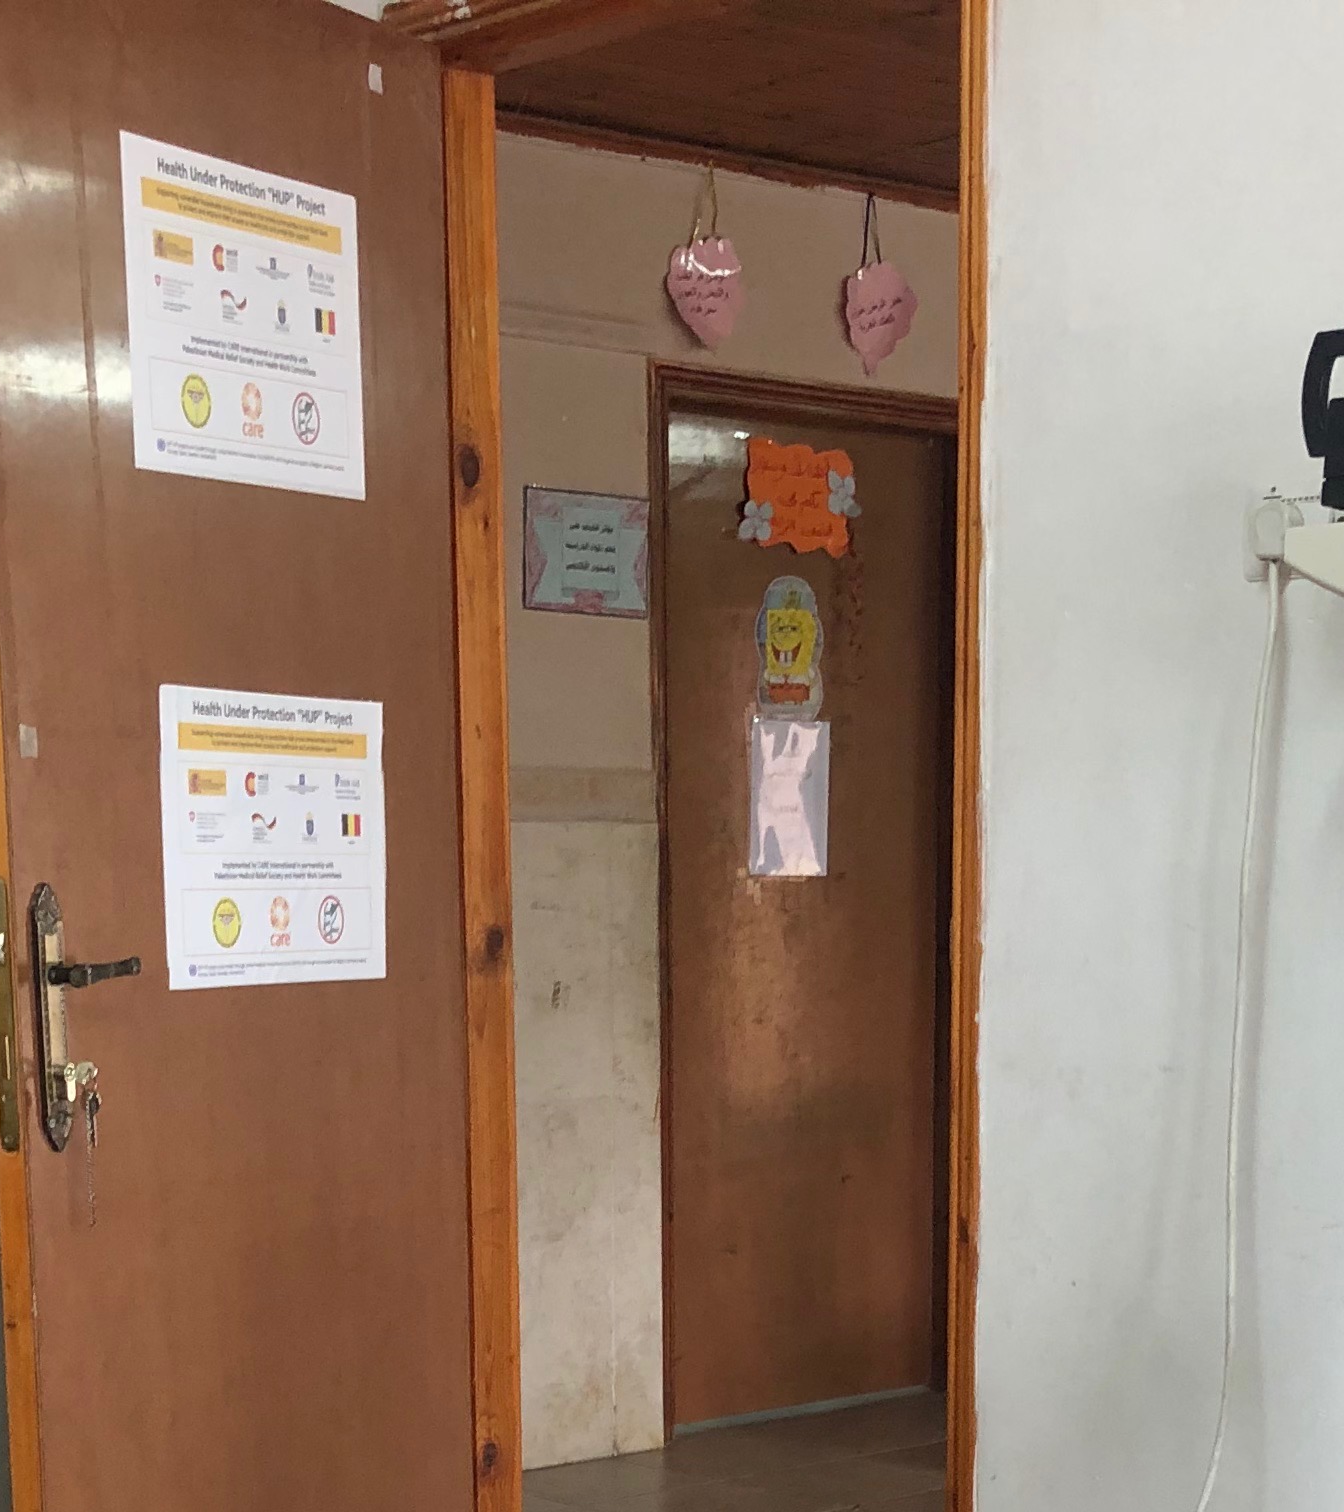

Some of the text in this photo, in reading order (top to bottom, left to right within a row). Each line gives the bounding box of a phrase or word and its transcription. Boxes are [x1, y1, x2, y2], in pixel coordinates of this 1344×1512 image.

[157, 157, 188, 180] Health
[190, 165, 218, 187] Under
[220, 173, 266, 201] Protection
[268, 186, 294, 206] "HUP"
[296, 194, 326, 217] Project
[242, 421, 264, 439] care
[192, 699, 353, 729] Health Under Protection "HUP" Project
[270, 932, 291, 947] care
